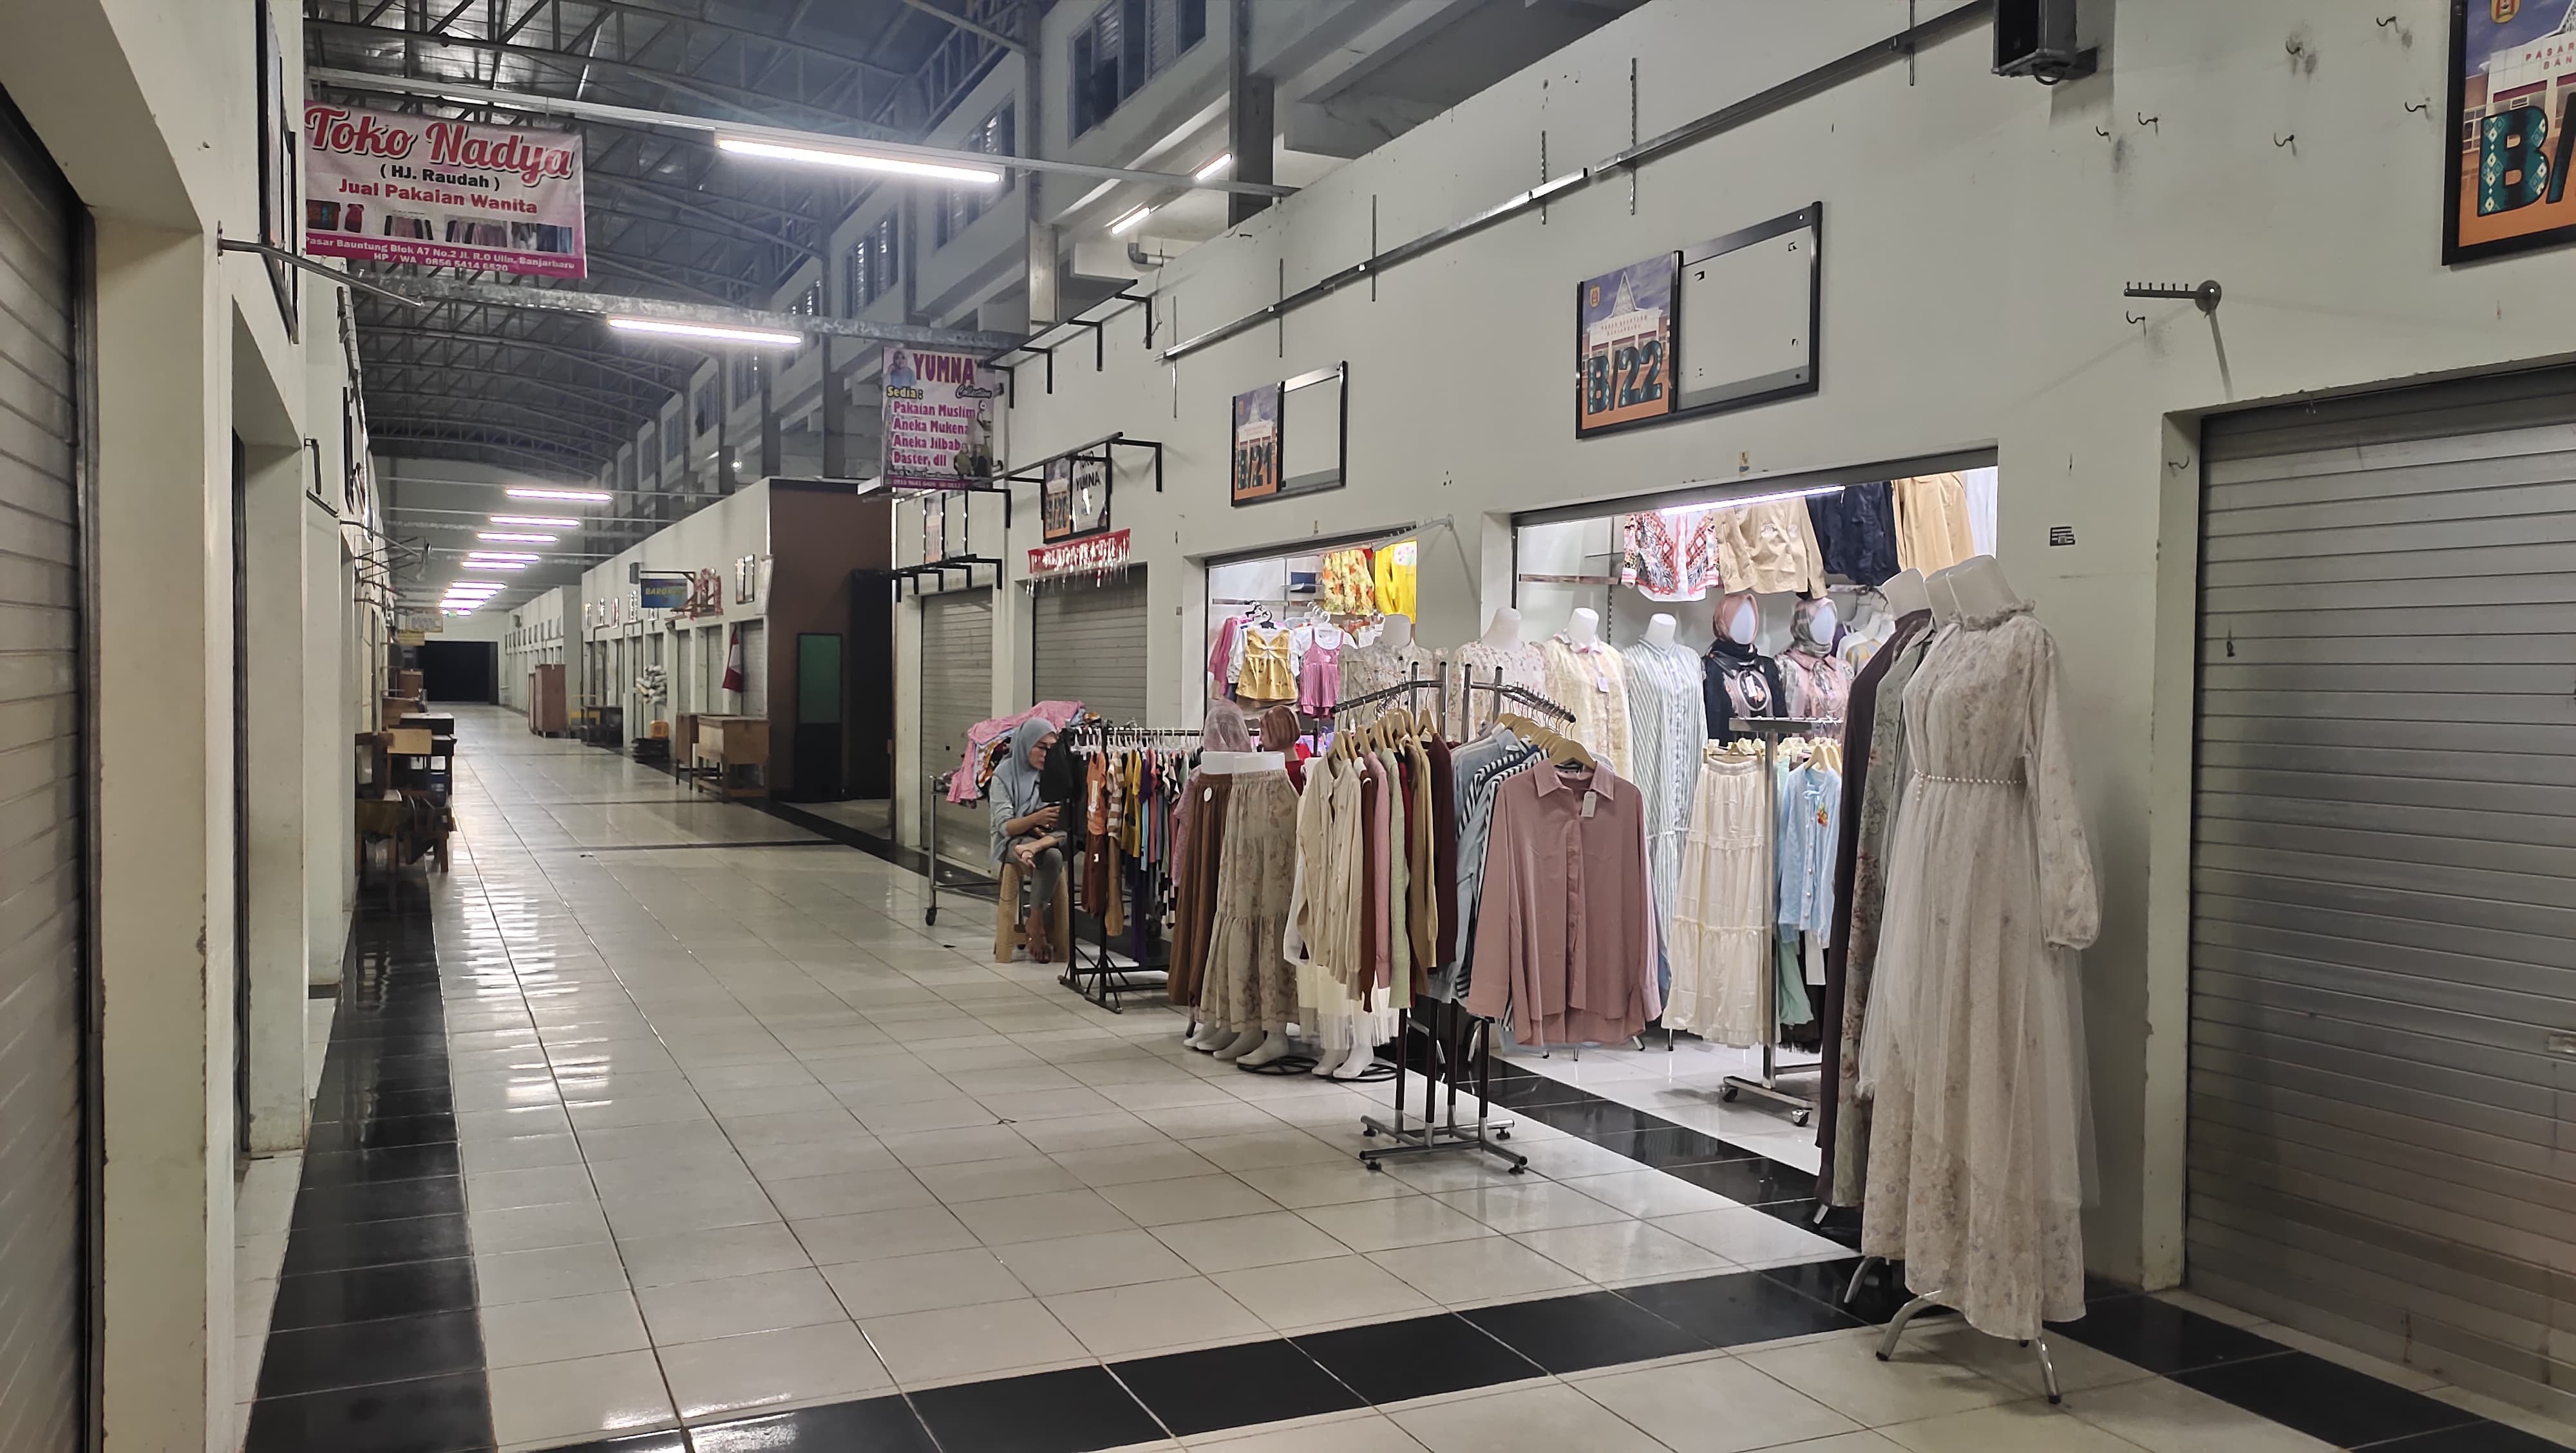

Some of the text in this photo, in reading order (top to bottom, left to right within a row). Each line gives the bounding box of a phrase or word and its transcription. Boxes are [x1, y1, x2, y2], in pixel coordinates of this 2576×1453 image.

[2525, 42, 2575, 62] PASAR
[305, 107, 573, 187] Toko Nadya
[422, 169, 489, 188] Raudah
[339, 178, 537, 214] Jual Pakaian Wanita
[337, 240, 388, 252] Bauntung
[390, 244, 413, 254] Blok
[433, 249, 457, 258] No.2
[519, 256, 575, 269] Banjarbaru
[913, 353, 975, 385] YUMNA
[1587, 340, 1663, 415] B/22
[893, 401, 976, 419] Pakaian Muslim
[893, 417, 927, 432] Aneka
[893, 434, 961, 451] Aneka Jilbab
[894, 451, 947, 467] Daster, dll
[1236, 442, 1273, 490] B/21
[1076, 471, 1101, 491] YUMNA
